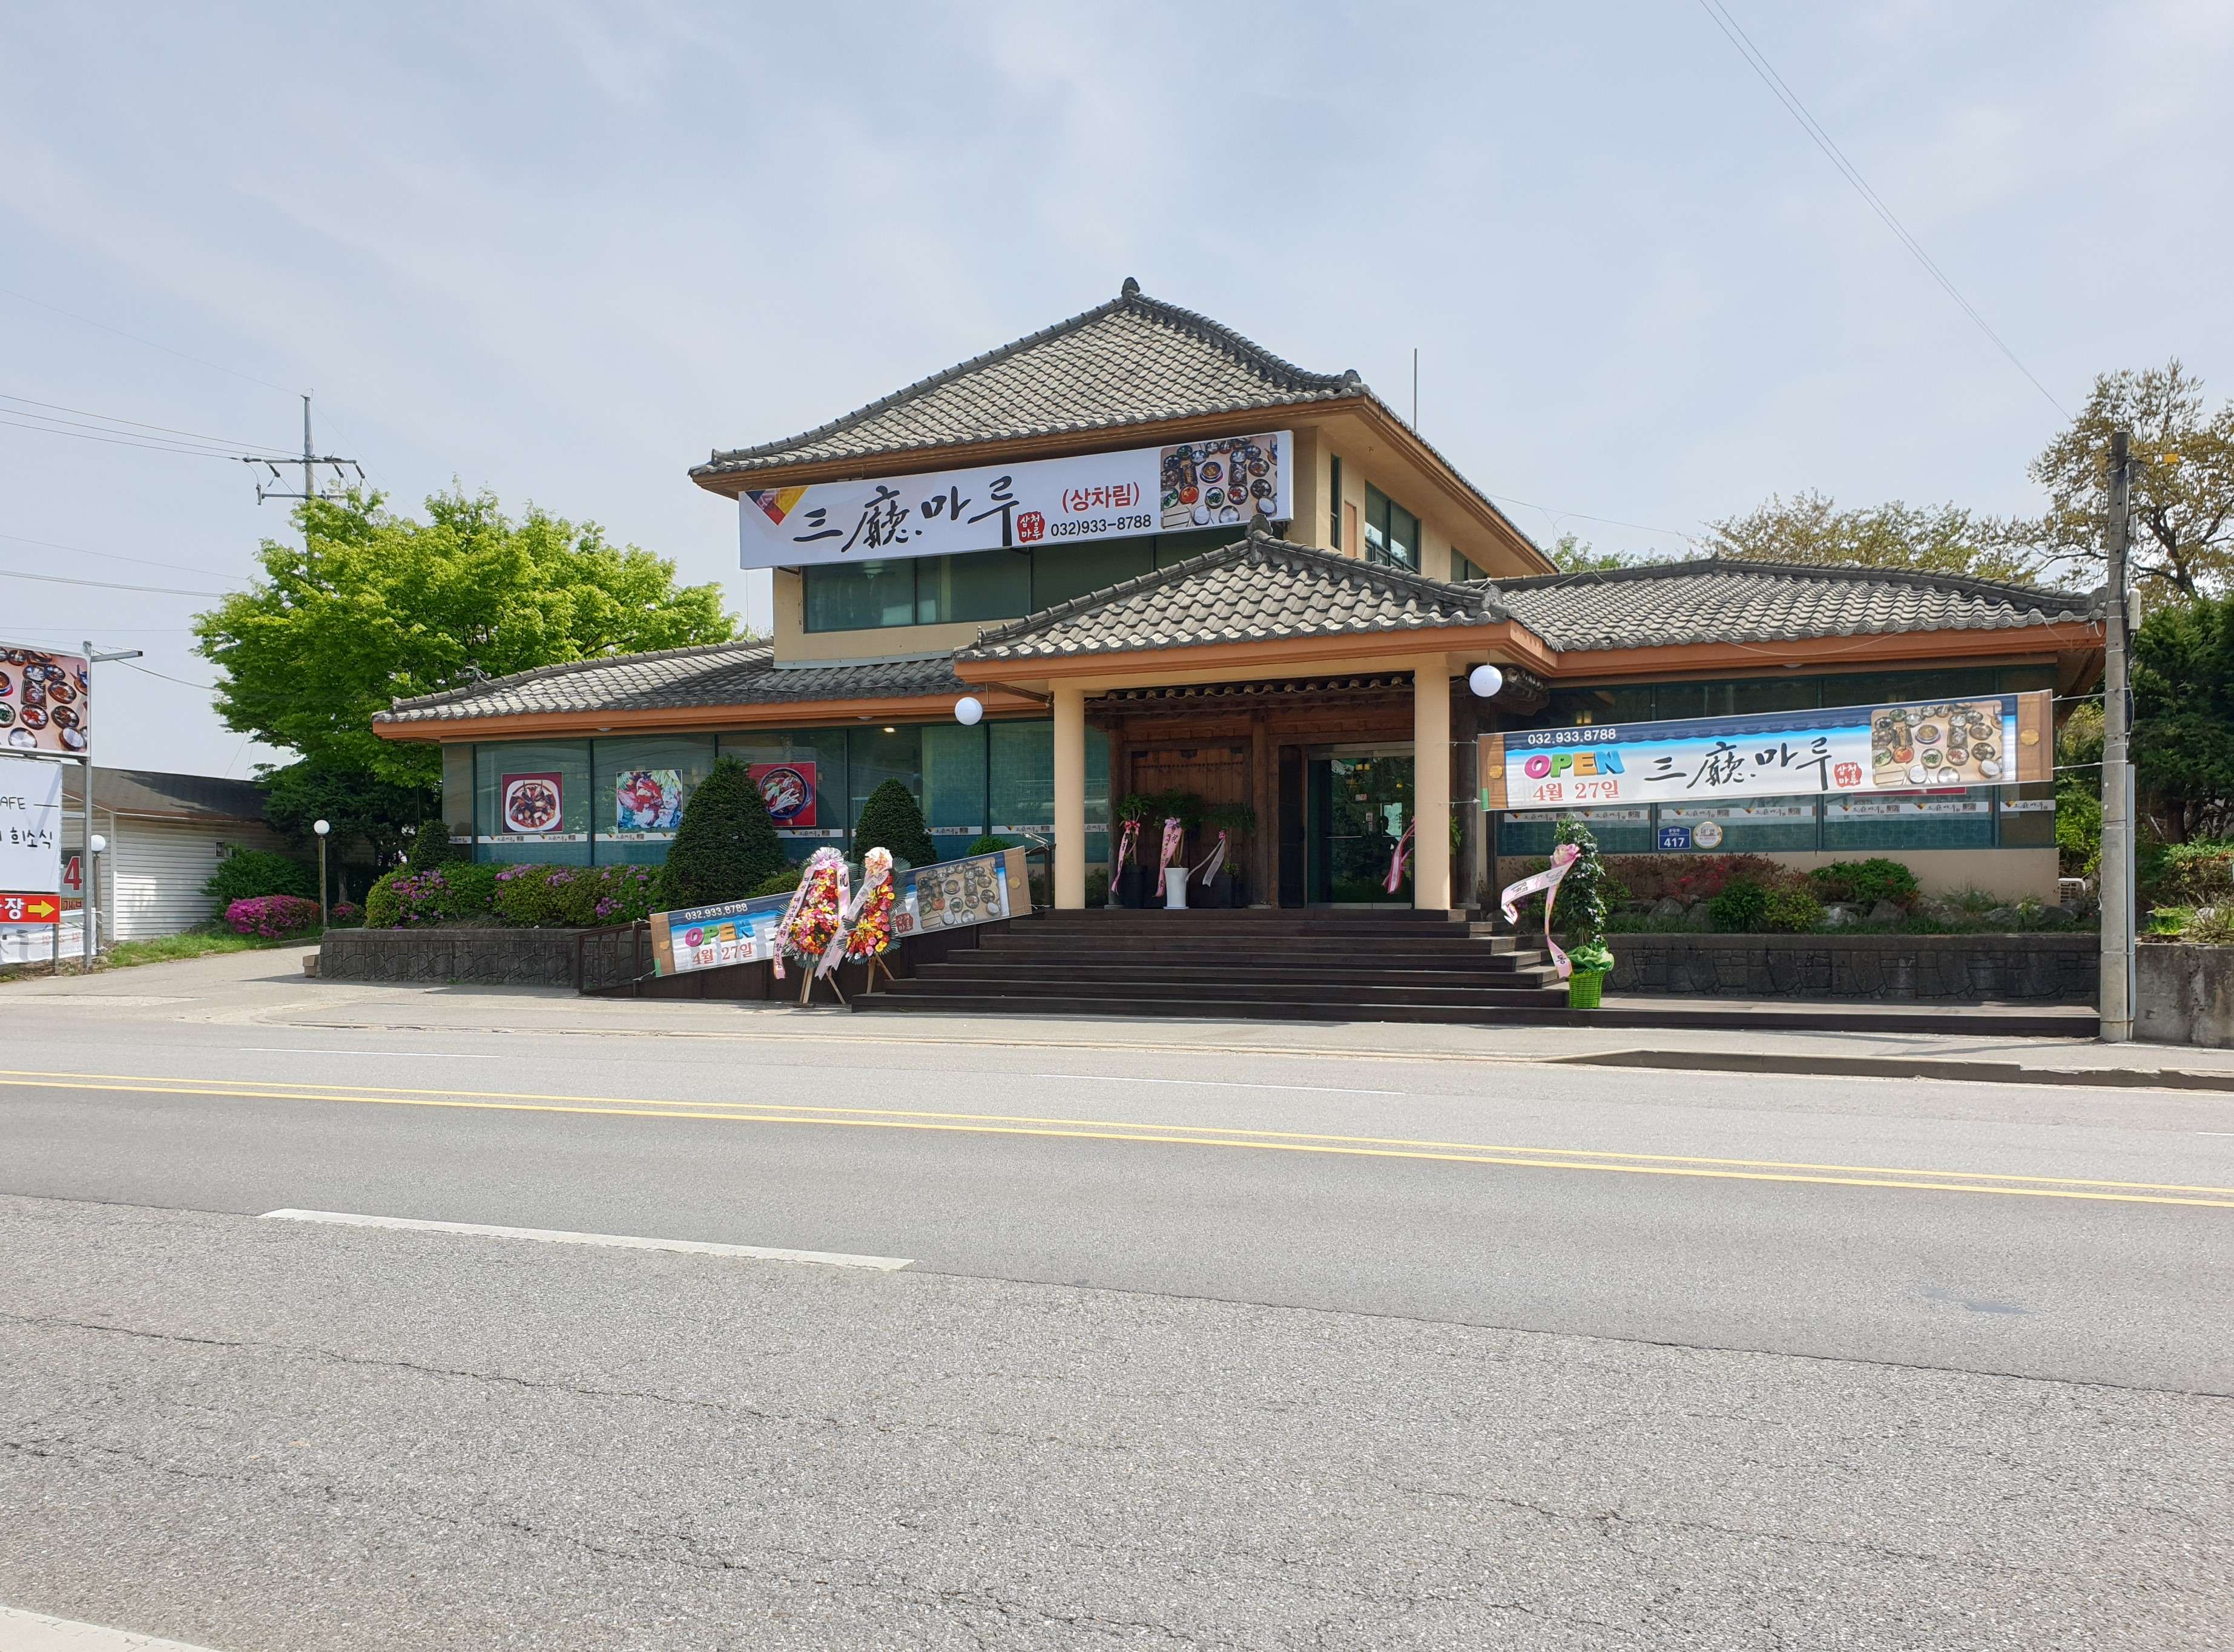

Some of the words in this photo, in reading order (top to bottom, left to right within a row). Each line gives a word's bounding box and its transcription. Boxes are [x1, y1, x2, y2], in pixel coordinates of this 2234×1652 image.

[1062, 481, 1140, 513] (상차림)
[1050, 514, 1152, 536] 032)933-8788
[1527, 728, 1616, 745] 032.933.8788
[1524, 751, 1625, 779] OPEN
[1533, 782, 1564, 801] 4월
[1575, 780, 1619, 799] 27일
[10, 827, 53, 849] 희소식
[1664, 837, 1685, 847] 417
[0, 898, 25, 920] 장
[685, 903, 748, 921] 032.933.8788
[685, 920, 756, 948] OPEN
[692, 948, 714, 965] 4월
[721, 942, 753, 961] 27일
